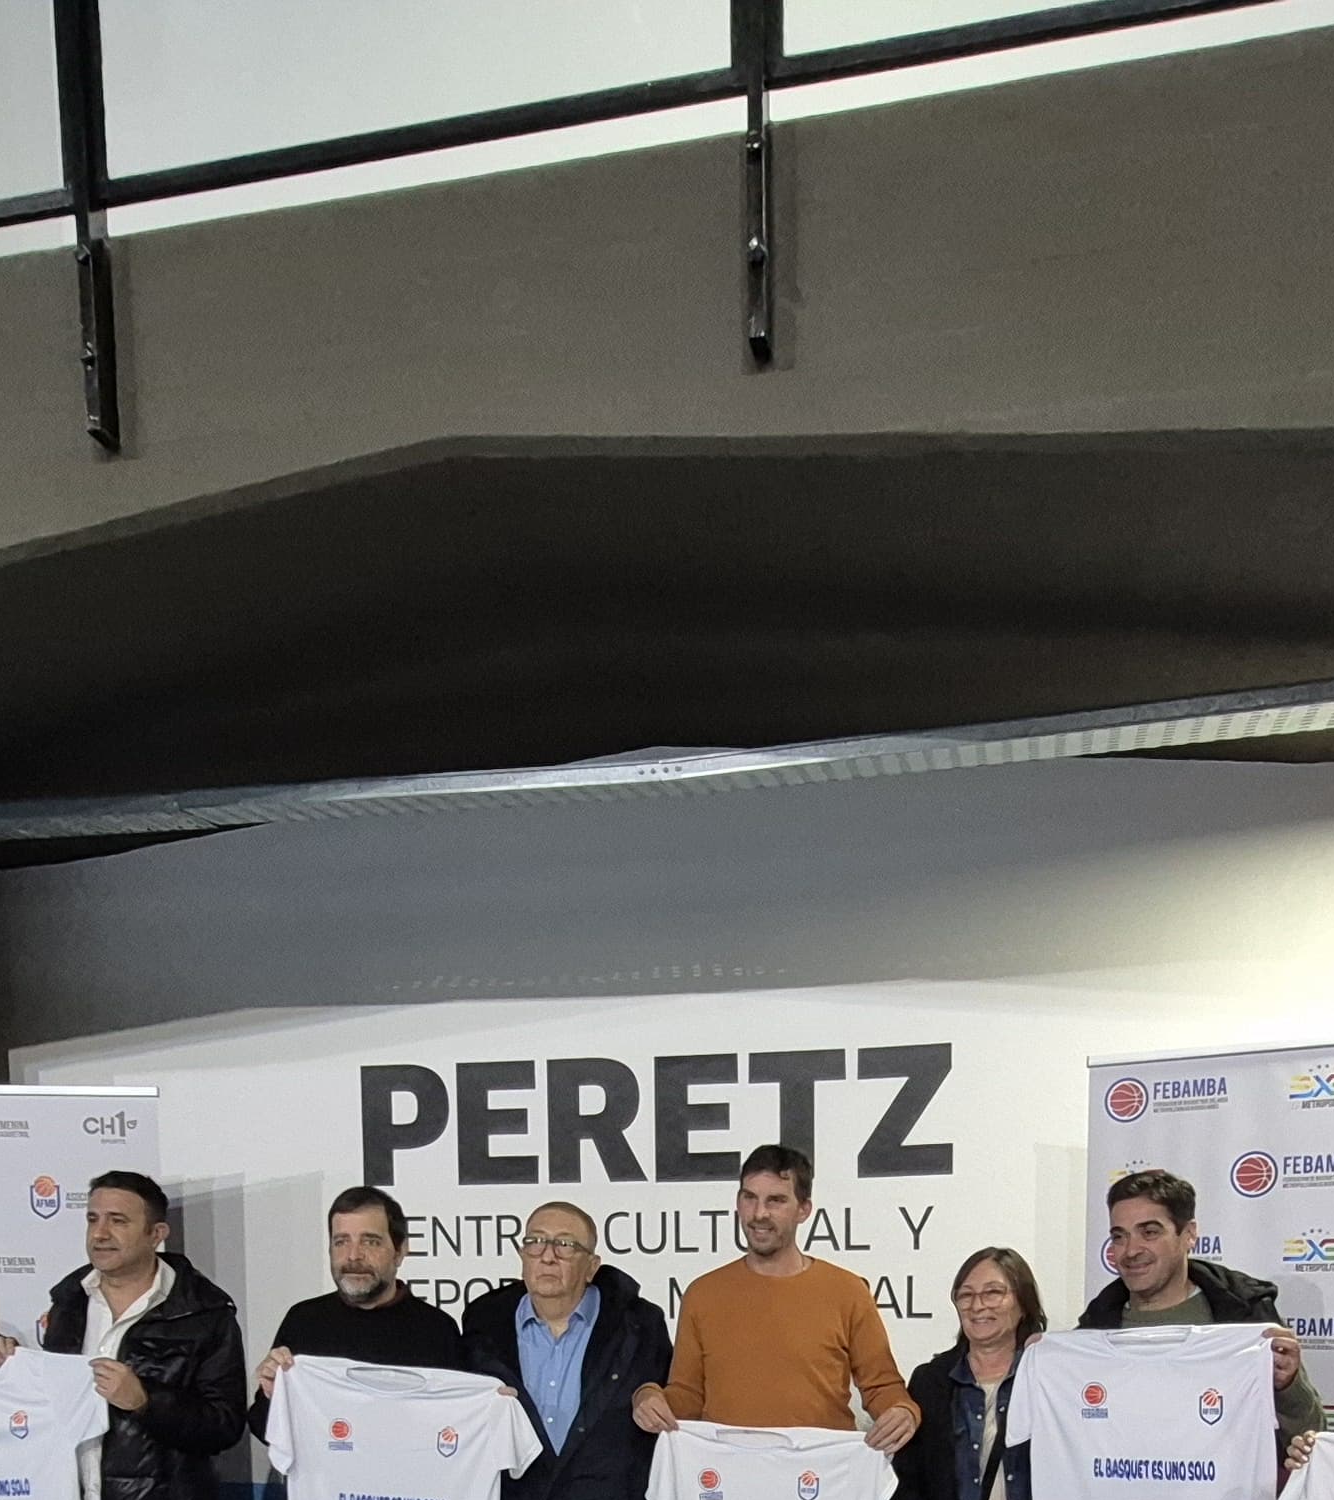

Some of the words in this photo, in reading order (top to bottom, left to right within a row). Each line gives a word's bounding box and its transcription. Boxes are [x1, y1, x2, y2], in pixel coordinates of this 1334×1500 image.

[1153, 1077, 1227, 1100] FEBAMBA
[360, 1042, 954, 1187] PERETZ
[899, 1206, 934, 1250] Y
[1094, 1458, 1104, 1477] EL
[1105, 1458, 1150, 1481] BASQUET
[1151, 1460, 1164, 1479] ES
[1165, 1461, 1186, 1481] UNO
[1187, 1461, 1215, 1481] SOLO
[11, 1478, 30, 1496] SOLO
